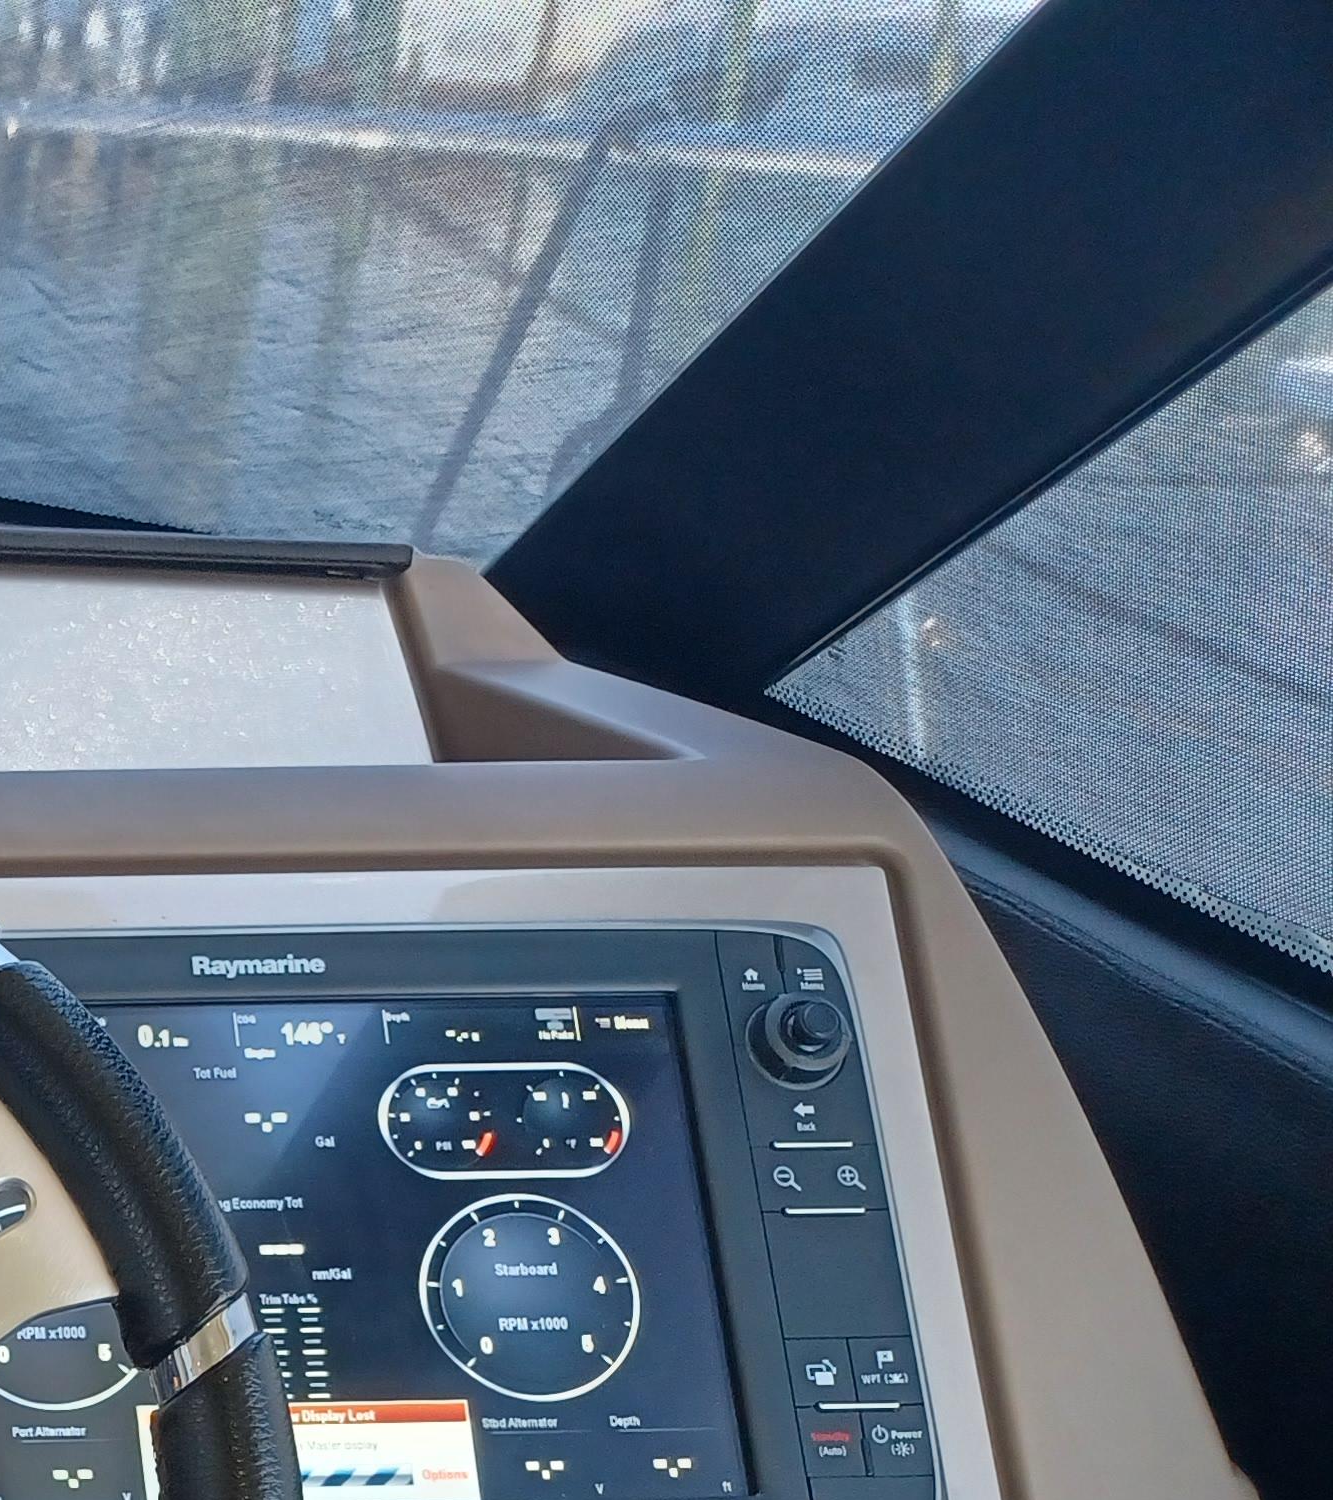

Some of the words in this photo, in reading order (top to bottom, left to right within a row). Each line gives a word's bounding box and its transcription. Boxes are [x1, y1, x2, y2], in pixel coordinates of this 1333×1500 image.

[191, 954, 326, 978] Raymarine
[213, 1066, 237, 1080] Fuel
[315, 1135, 336, 1148] Gal
[232, 1197, 284, 1212] Economy
[285, 1196, 304, 1209] Tot
[481, 1228, 496, 1248] 2
[547, 1227, 561, 1247] 3
[494, 1262, 558, 1278] Starboard
[451, 1278, 464, 1298] 1
[592, 1275, 607, 1295] 4
[48, 1325, 86, 1340] x1000
[498, 1316, 529, 1333] RPM
[531, 1315, 569, 1332] x1000
[479, 1335, 494, 1356] 0
[301, 1409, 347, 1424] Display
[347, 1407, 376, 1422] Lost
[609, 1414, 642, 1429] Depth
[422, 1468, 469, 1482] Options
